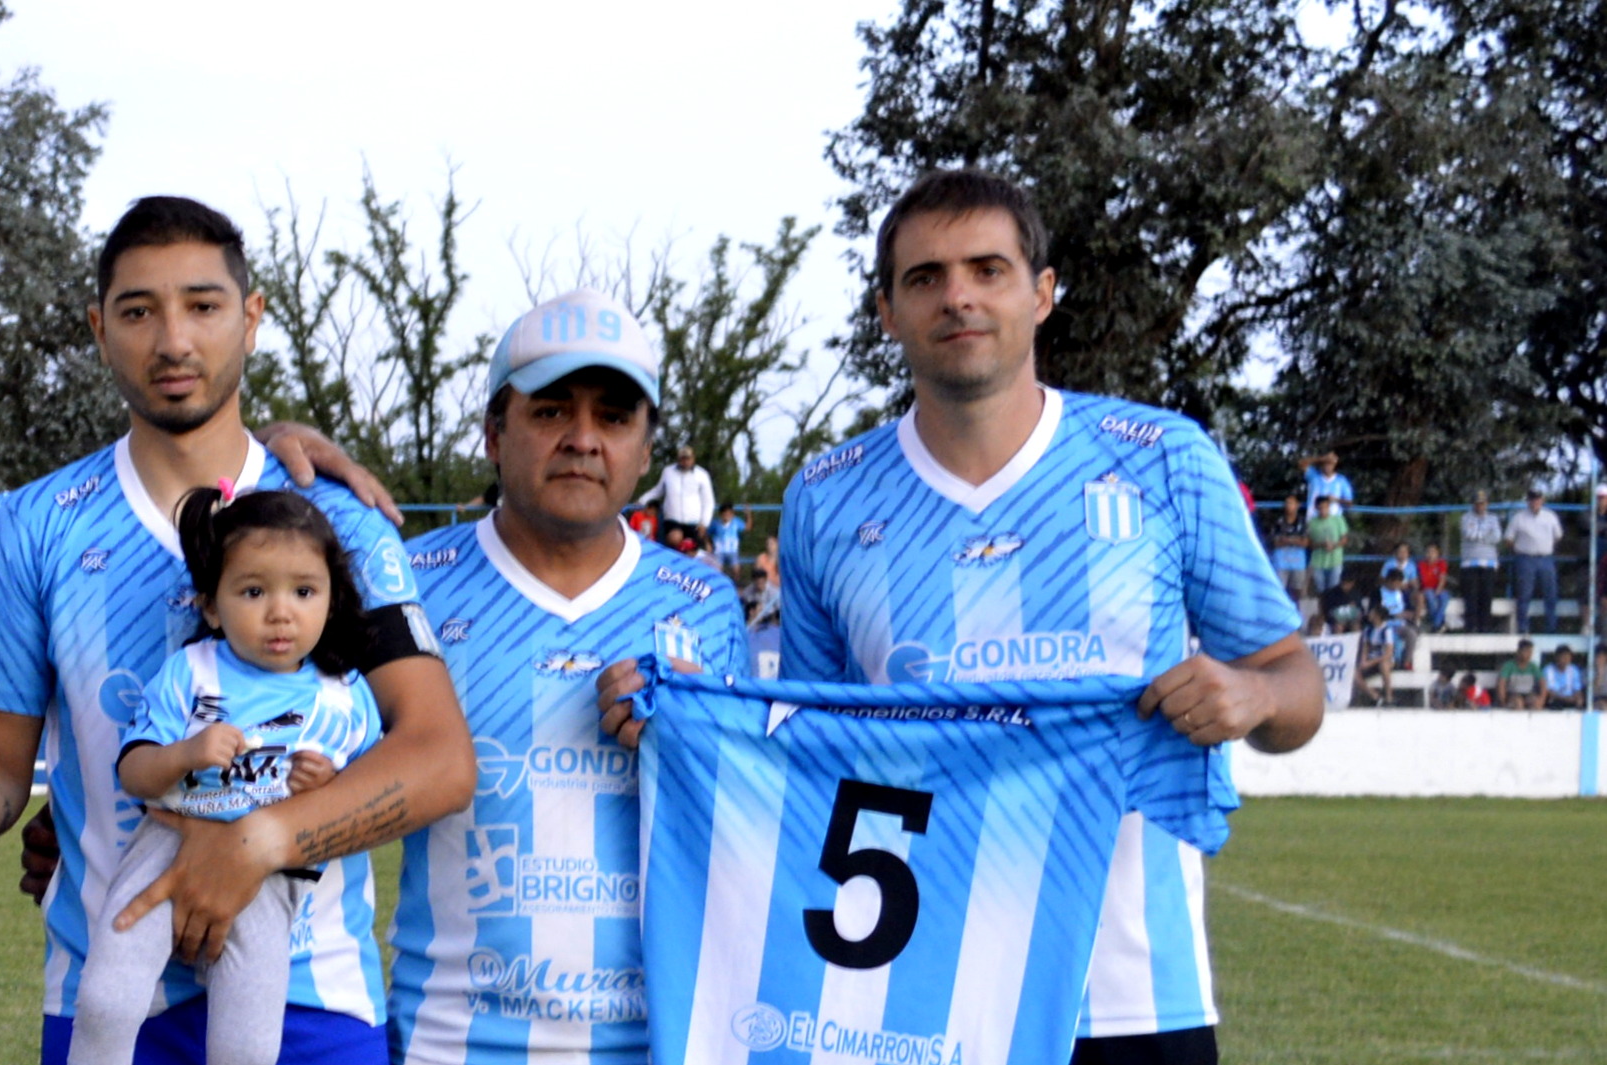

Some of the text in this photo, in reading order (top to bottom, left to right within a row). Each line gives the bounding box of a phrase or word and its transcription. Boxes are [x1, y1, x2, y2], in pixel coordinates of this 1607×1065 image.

[953, 634, 1107, 671] GONDRA
[529, 748, 639, 777] GOND
[521, 857, 595, 873] ESTUDIO
[802, 777, 935, 971] 5
[522, 874, 639, 902] BRIGNO
[502, 955, 645, 994] Mura
[503, 996, 644, 1022] MACKENN
[790, 1015, 816, 1048] EL
